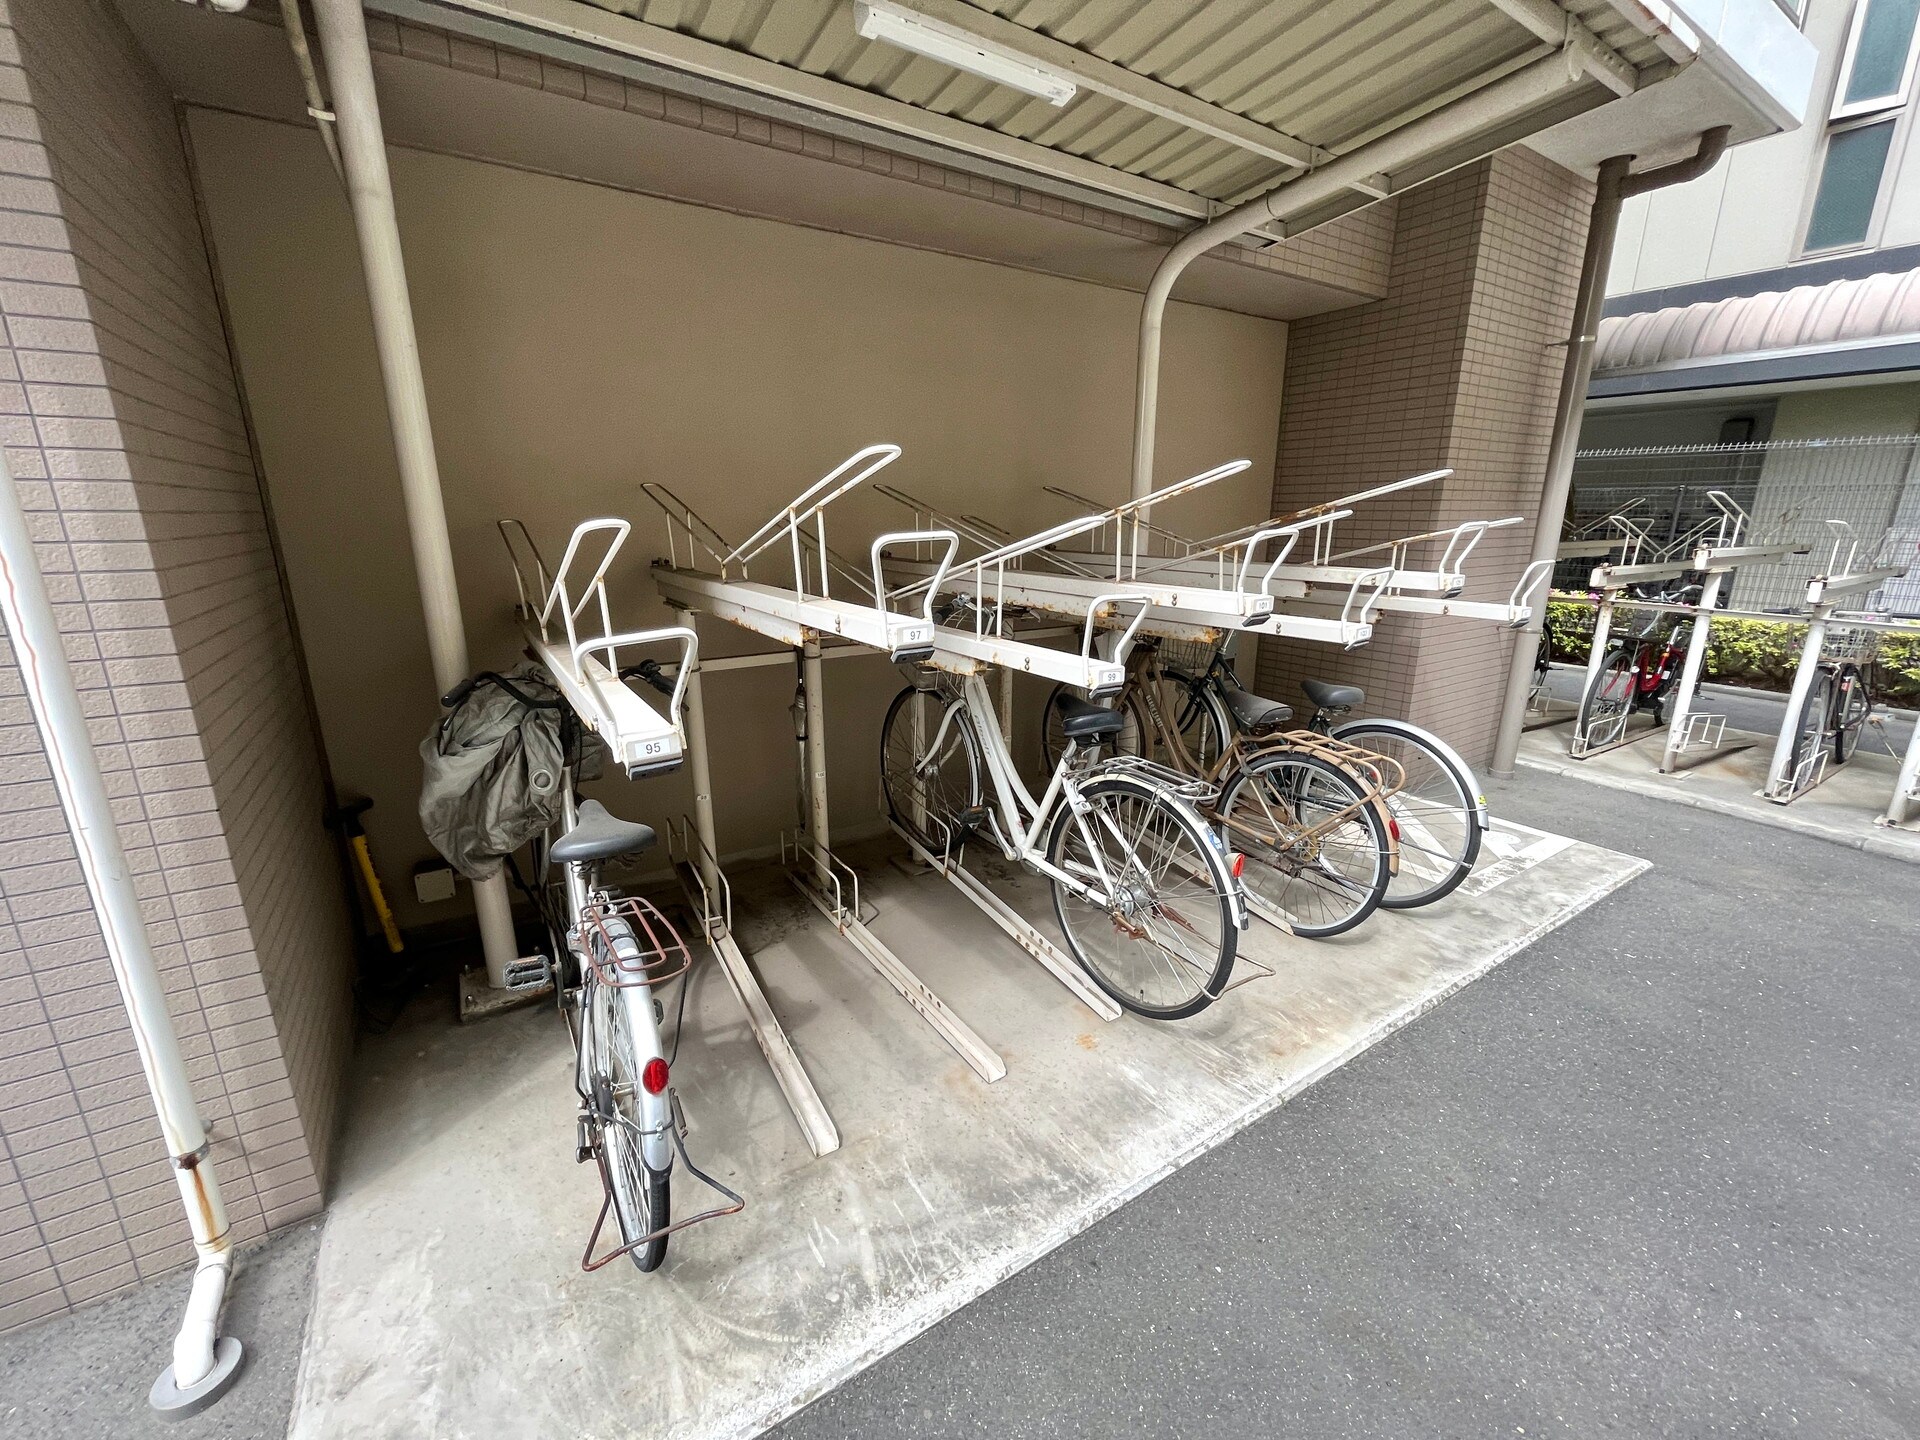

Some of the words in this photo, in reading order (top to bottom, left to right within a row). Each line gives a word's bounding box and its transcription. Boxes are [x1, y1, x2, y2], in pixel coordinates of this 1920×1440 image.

[910, 631, 921, 641] 97
[1107, 673, 1116, 681] 99
[645, 742, 661, 755] 95
